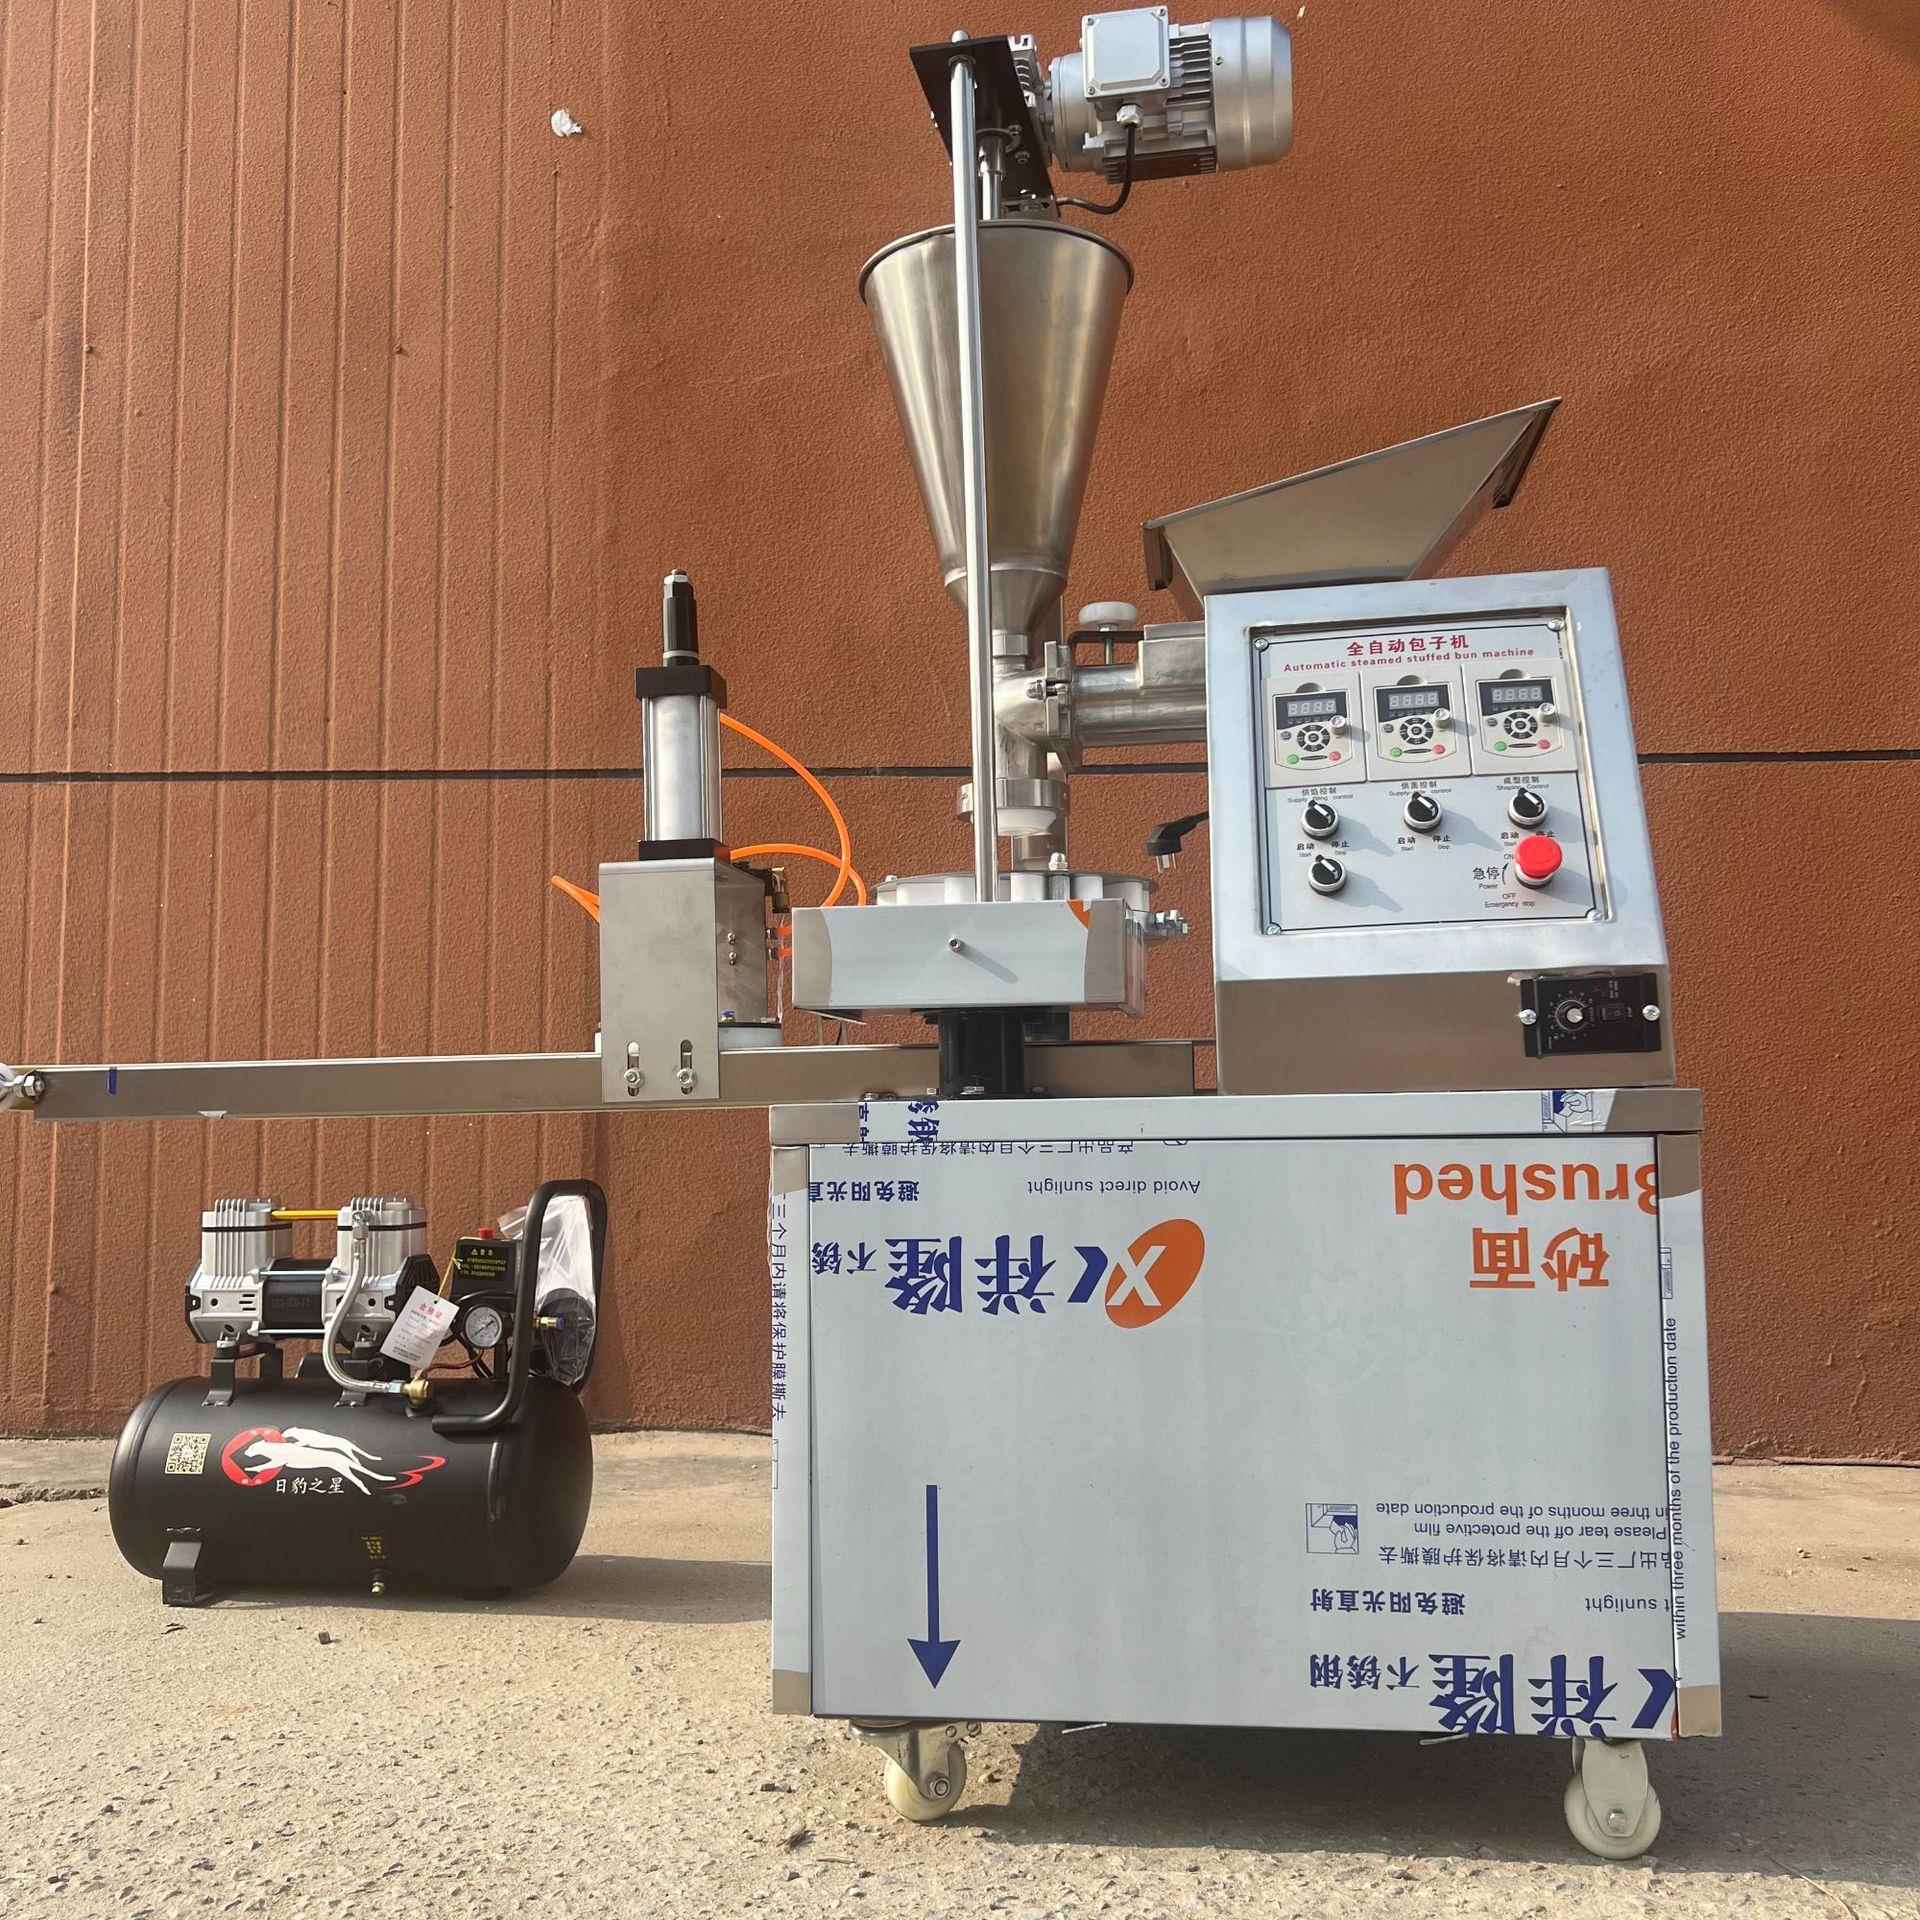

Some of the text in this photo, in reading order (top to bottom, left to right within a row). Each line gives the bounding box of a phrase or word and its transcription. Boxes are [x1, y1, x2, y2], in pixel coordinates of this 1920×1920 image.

[1347, 634, 1469, 656] 全自动包子机
[1284, 648, 1534, 672] Automatic steamed stuffed bun machine
[1398, 836, 1416, 844] 启动
[1432, 834, 1451, 842] 停止
[1501, 831, 1519, 839] 启动
[1297, 842, 1315, 851] 启动
[1331, 840, 1350, 848] 停止
[1472, 866, 1500, 880] 急停
[1028, 1178, 1201, 1194] Avoid direct sunlight
[1470, 1227, 1610, 1292] 砂面
[884, 1234, 1056, 1316] 祥隆
[771, 1187, 788, 1421] 三个月内请将保护膜撕去
[275, 1476, 345, 1494] 日豹之星
[1664, 1318, 1686, 1640] within three months of the production date
[1375, 1502, 1410, 1514] date
[1415, 1502, 1494, 1516] production
[1500, 1503, 1524, 1516] the
[1527, 1503, 1544, 1516] of
[1548, 1503, 1605, 1516] months
[1610, 1503, 1650, 1516] three
[1414, 1523, 1666, 1539] Please tear off the protective film
[1311, 1588, 1465, 1616] 避免阳光直射
[1586, 1597, 1657, 1613] sunlight
[1310, 1653, 1617, 1737] 祥隆 不锈钢
